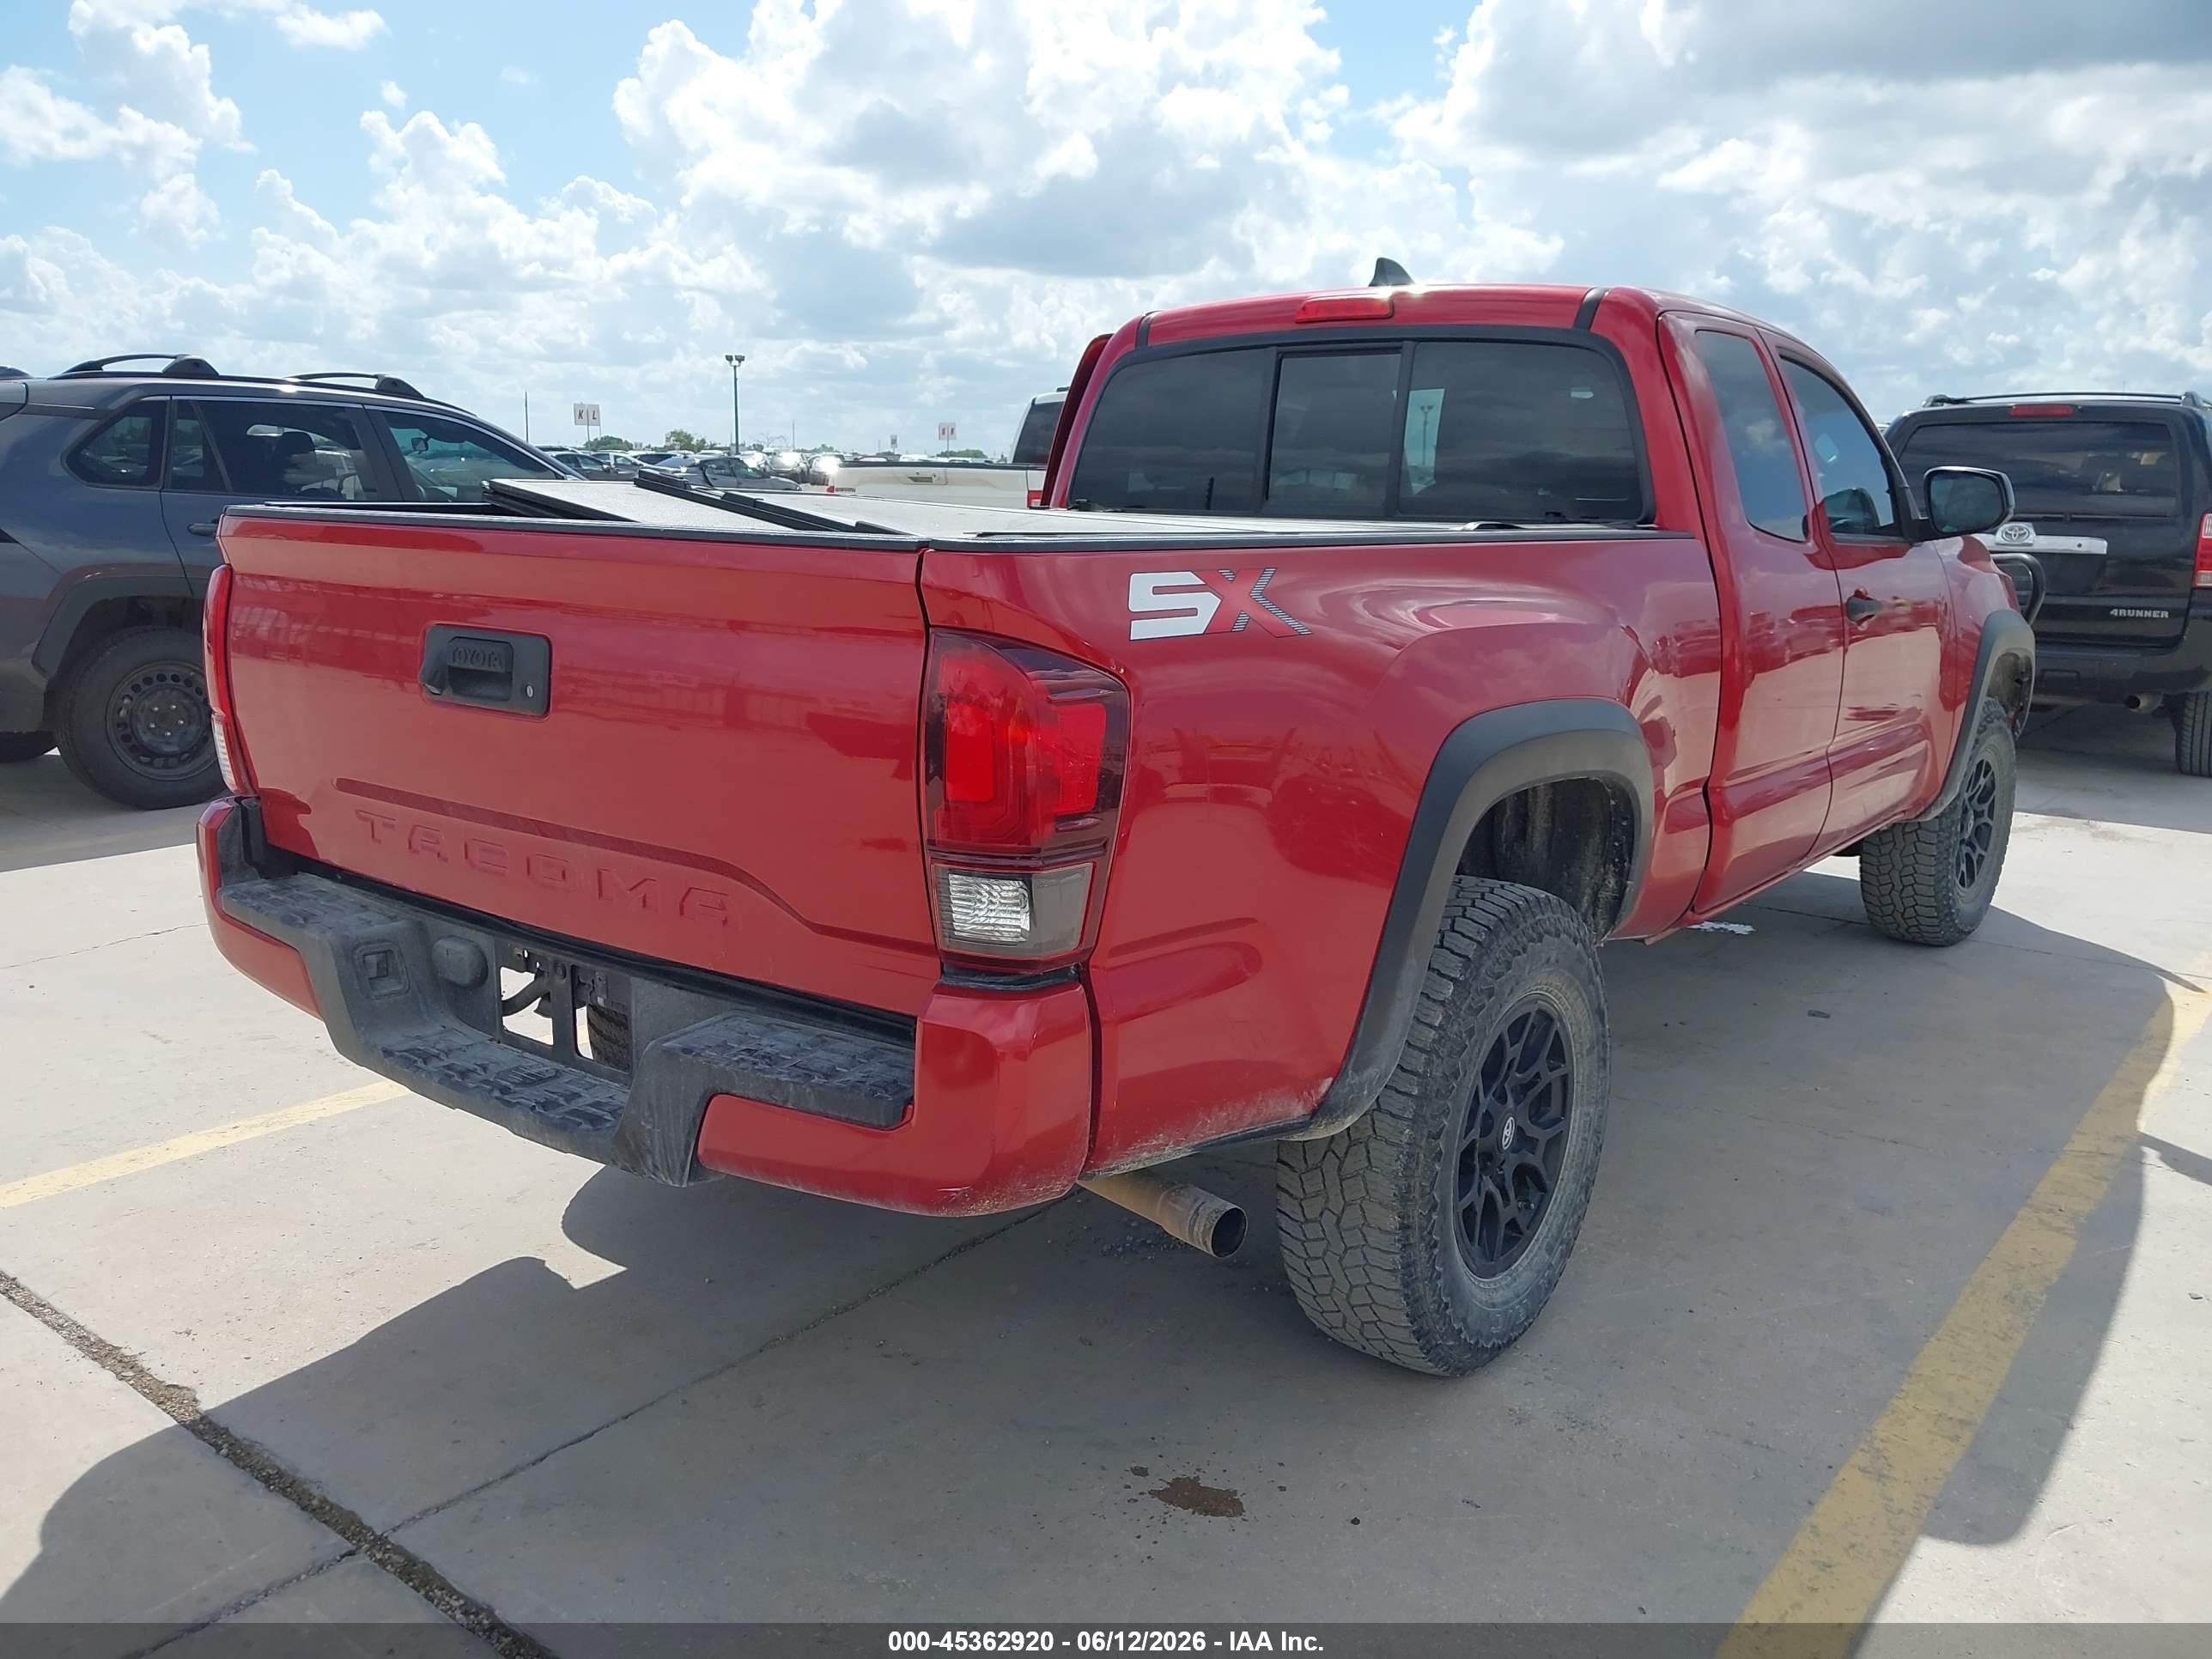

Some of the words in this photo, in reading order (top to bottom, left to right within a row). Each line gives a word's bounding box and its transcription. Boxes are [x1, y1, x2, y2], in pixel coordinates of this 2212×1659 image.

[578, 409, 584, 420] K
[592, 410, 597, 420] L
[1128, 568, 1313, 641] SX
[2109, 608, 2169, 618] 4RUNNER
[449, 646, 504, 670] TOYOTA
[355, 809, 743, 933] TACOMA
